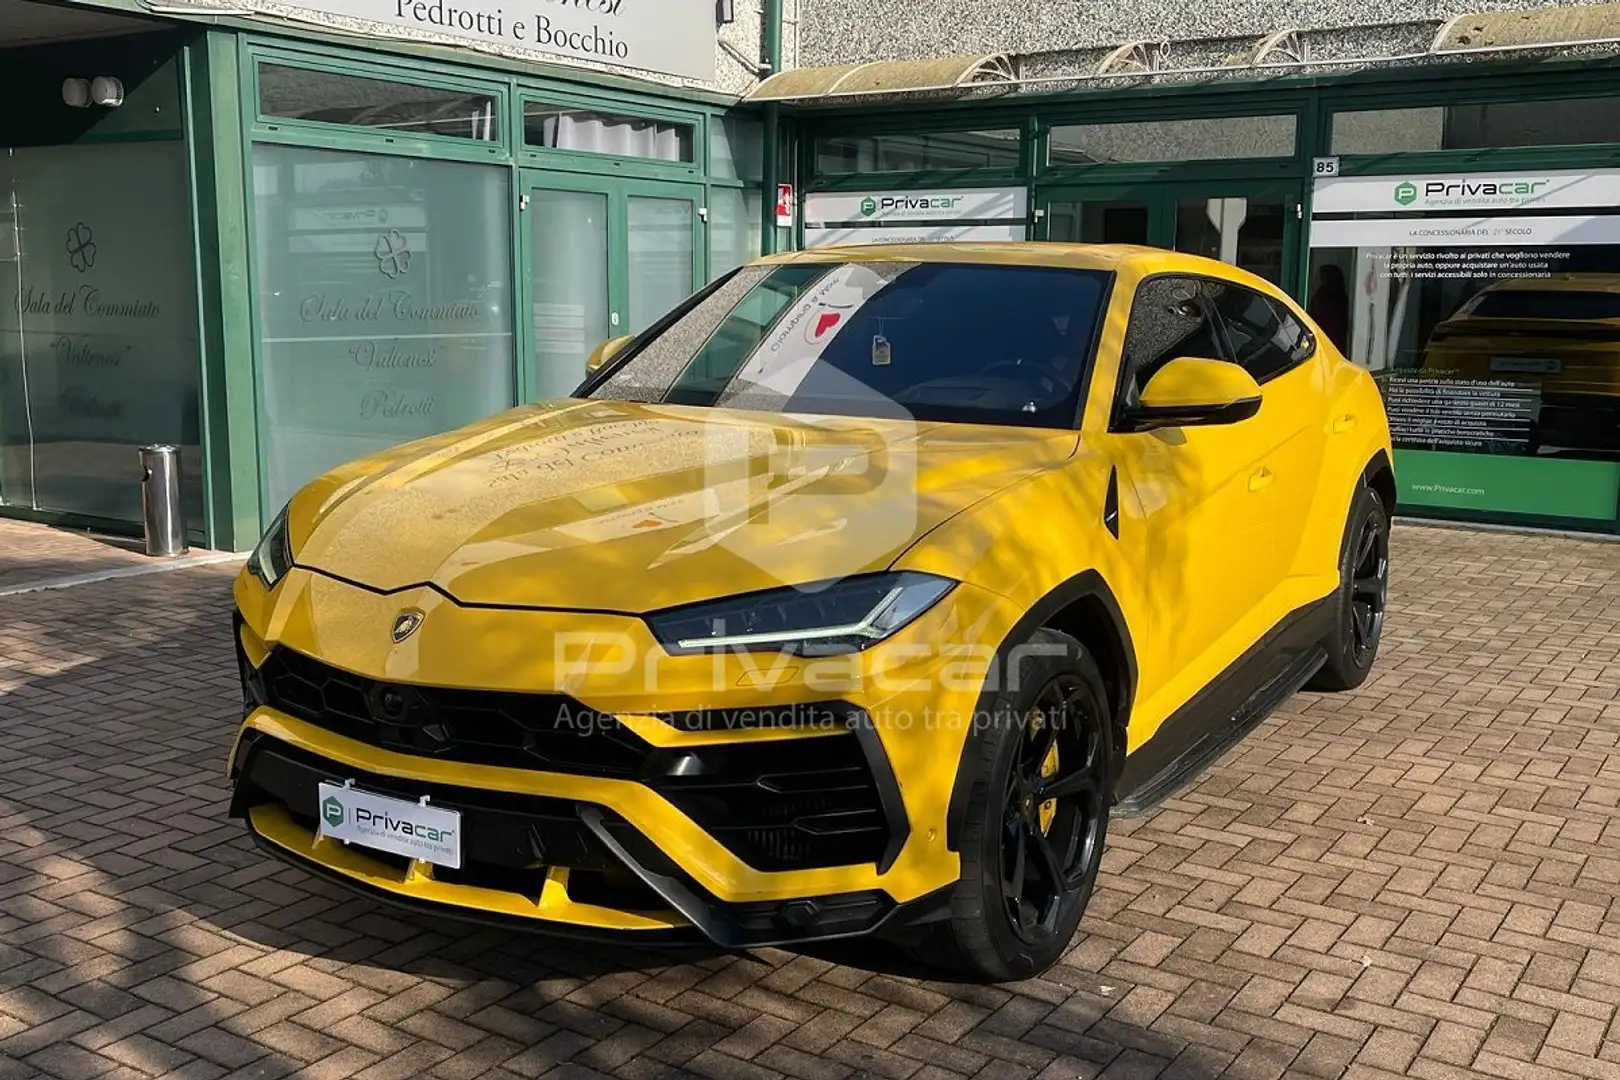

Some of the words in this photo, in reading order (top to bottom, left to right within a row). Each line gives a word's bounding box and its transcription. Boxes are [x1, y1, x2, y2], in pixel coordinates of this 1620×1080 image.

[395, 0, 503, 37] Pedrotti
[513, 20, 525, 40] e
[535, 14, 628, 58] Bocchio
[1316, 161, 1334, 173] 85
[1425, 179, 1547, 196] Privacar
[881, 195, 962, 209] Privacar
[1491, 250, 1505, 259] che
[1539, 250, 1571, 259] vendere
[54, 291, 76, 316] del
[356, 808, 453, 842] Privacar
